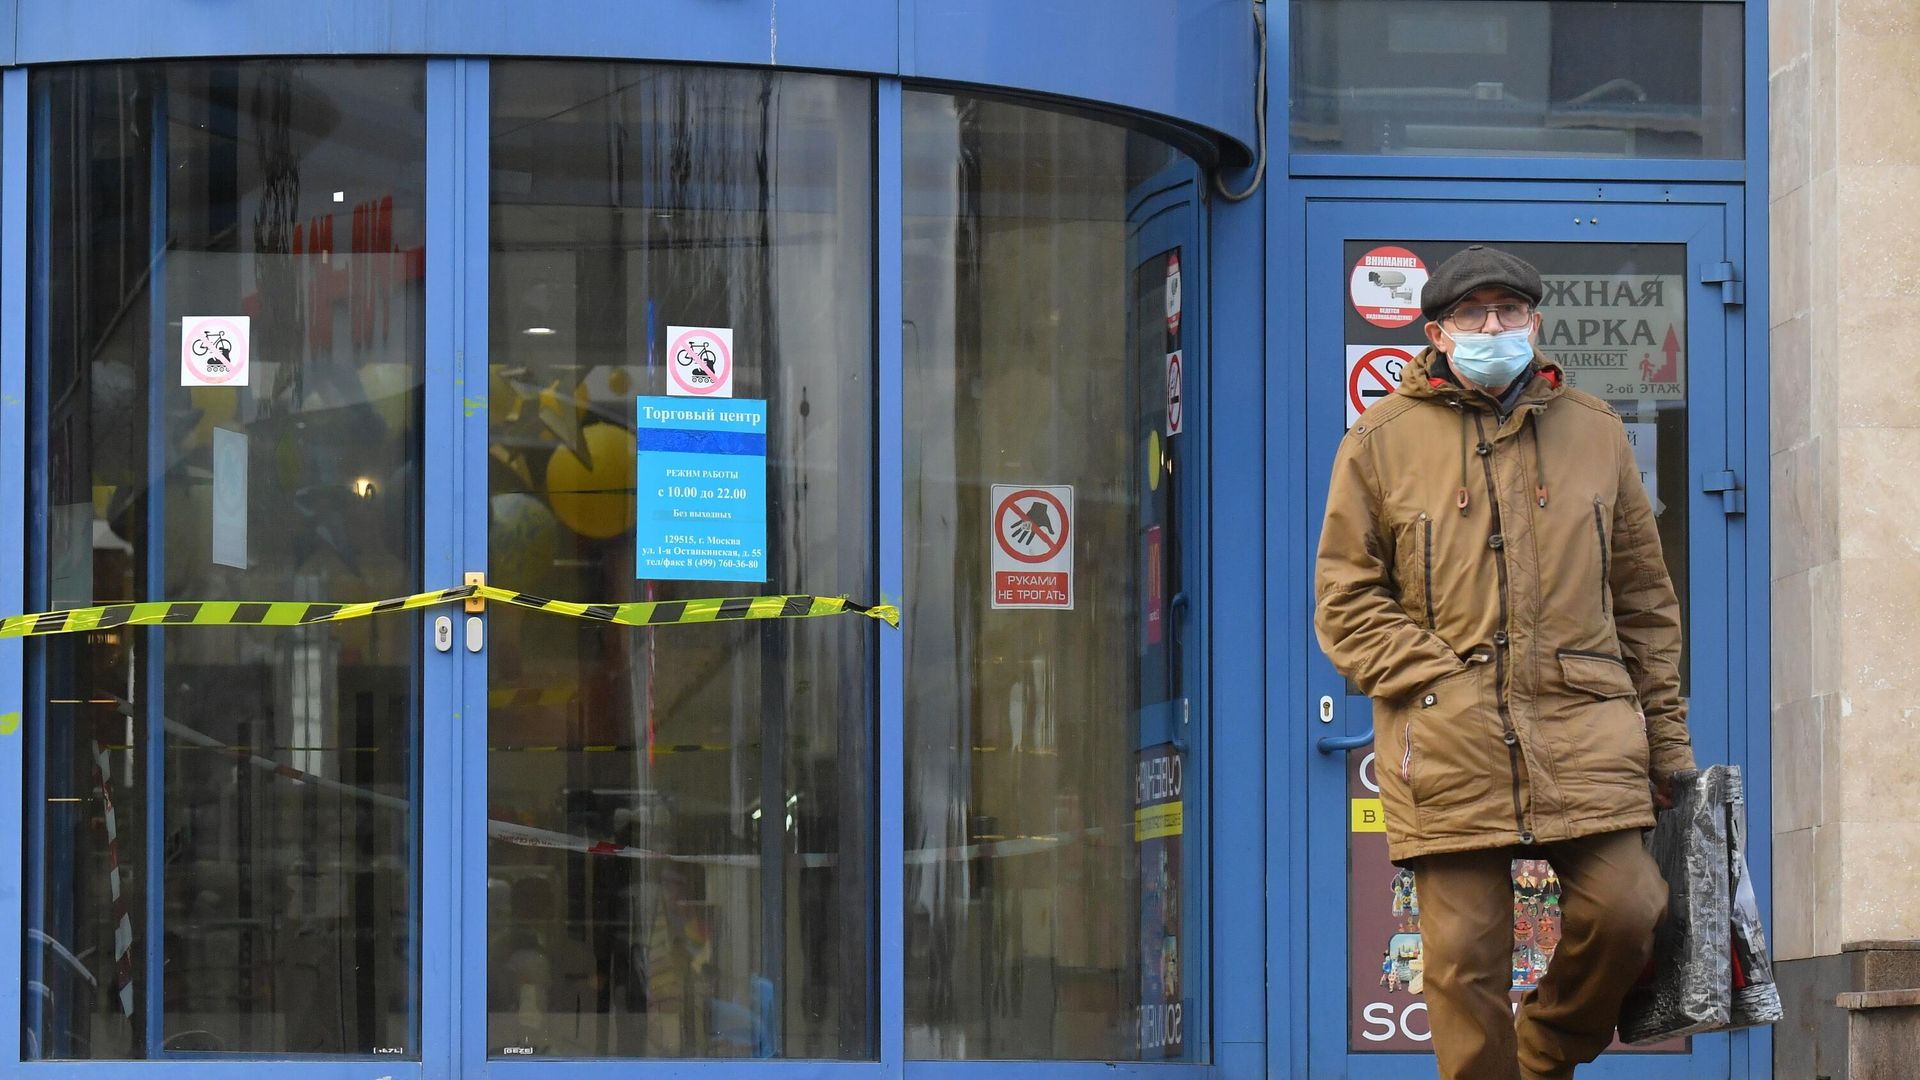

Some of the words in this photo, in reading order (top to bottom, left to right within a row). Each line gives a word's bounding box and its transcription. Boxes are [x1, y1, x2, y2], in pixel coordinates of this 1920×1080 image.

[1540, 281, 1664, 307] ЖНАЯ
[1555, 353, 1628, 367] MARKET
[1606, 383, 1634, 394] 2-ой
[1640, 384, 1680, 394] ЭТАЖ
[643, 406, 715, 423] Торговый
[720, 411, 761, 426] центр
[666, 469, 700, 478] РЕЖИМ
[702, 470, 739, 479] РАБОТЫ
[658, 488, 664, 497] с
[668, 486, 698, 498] 10.00
[700, 490, 714, 499] до
[717, 488, 747, 499] 22.00
[673, 508, 687, 518] Без
[690, 511, 732, 519] выходных
[707, 536, 741, 546] Москва
[752, 549, 762, 558] 55
[646, 558, 686, 568] тел/факс
[687, 559, 693, 567] 8
[694, 558, 716, 568] (499)
[718, 560, 758, 569] 760-36-80
[1008, 575, 1057, 585] РУКАМИ
[998, 590, 1013, 600] НЕ
[1017, 590, 1066, 600] ТРОГАТЬ
